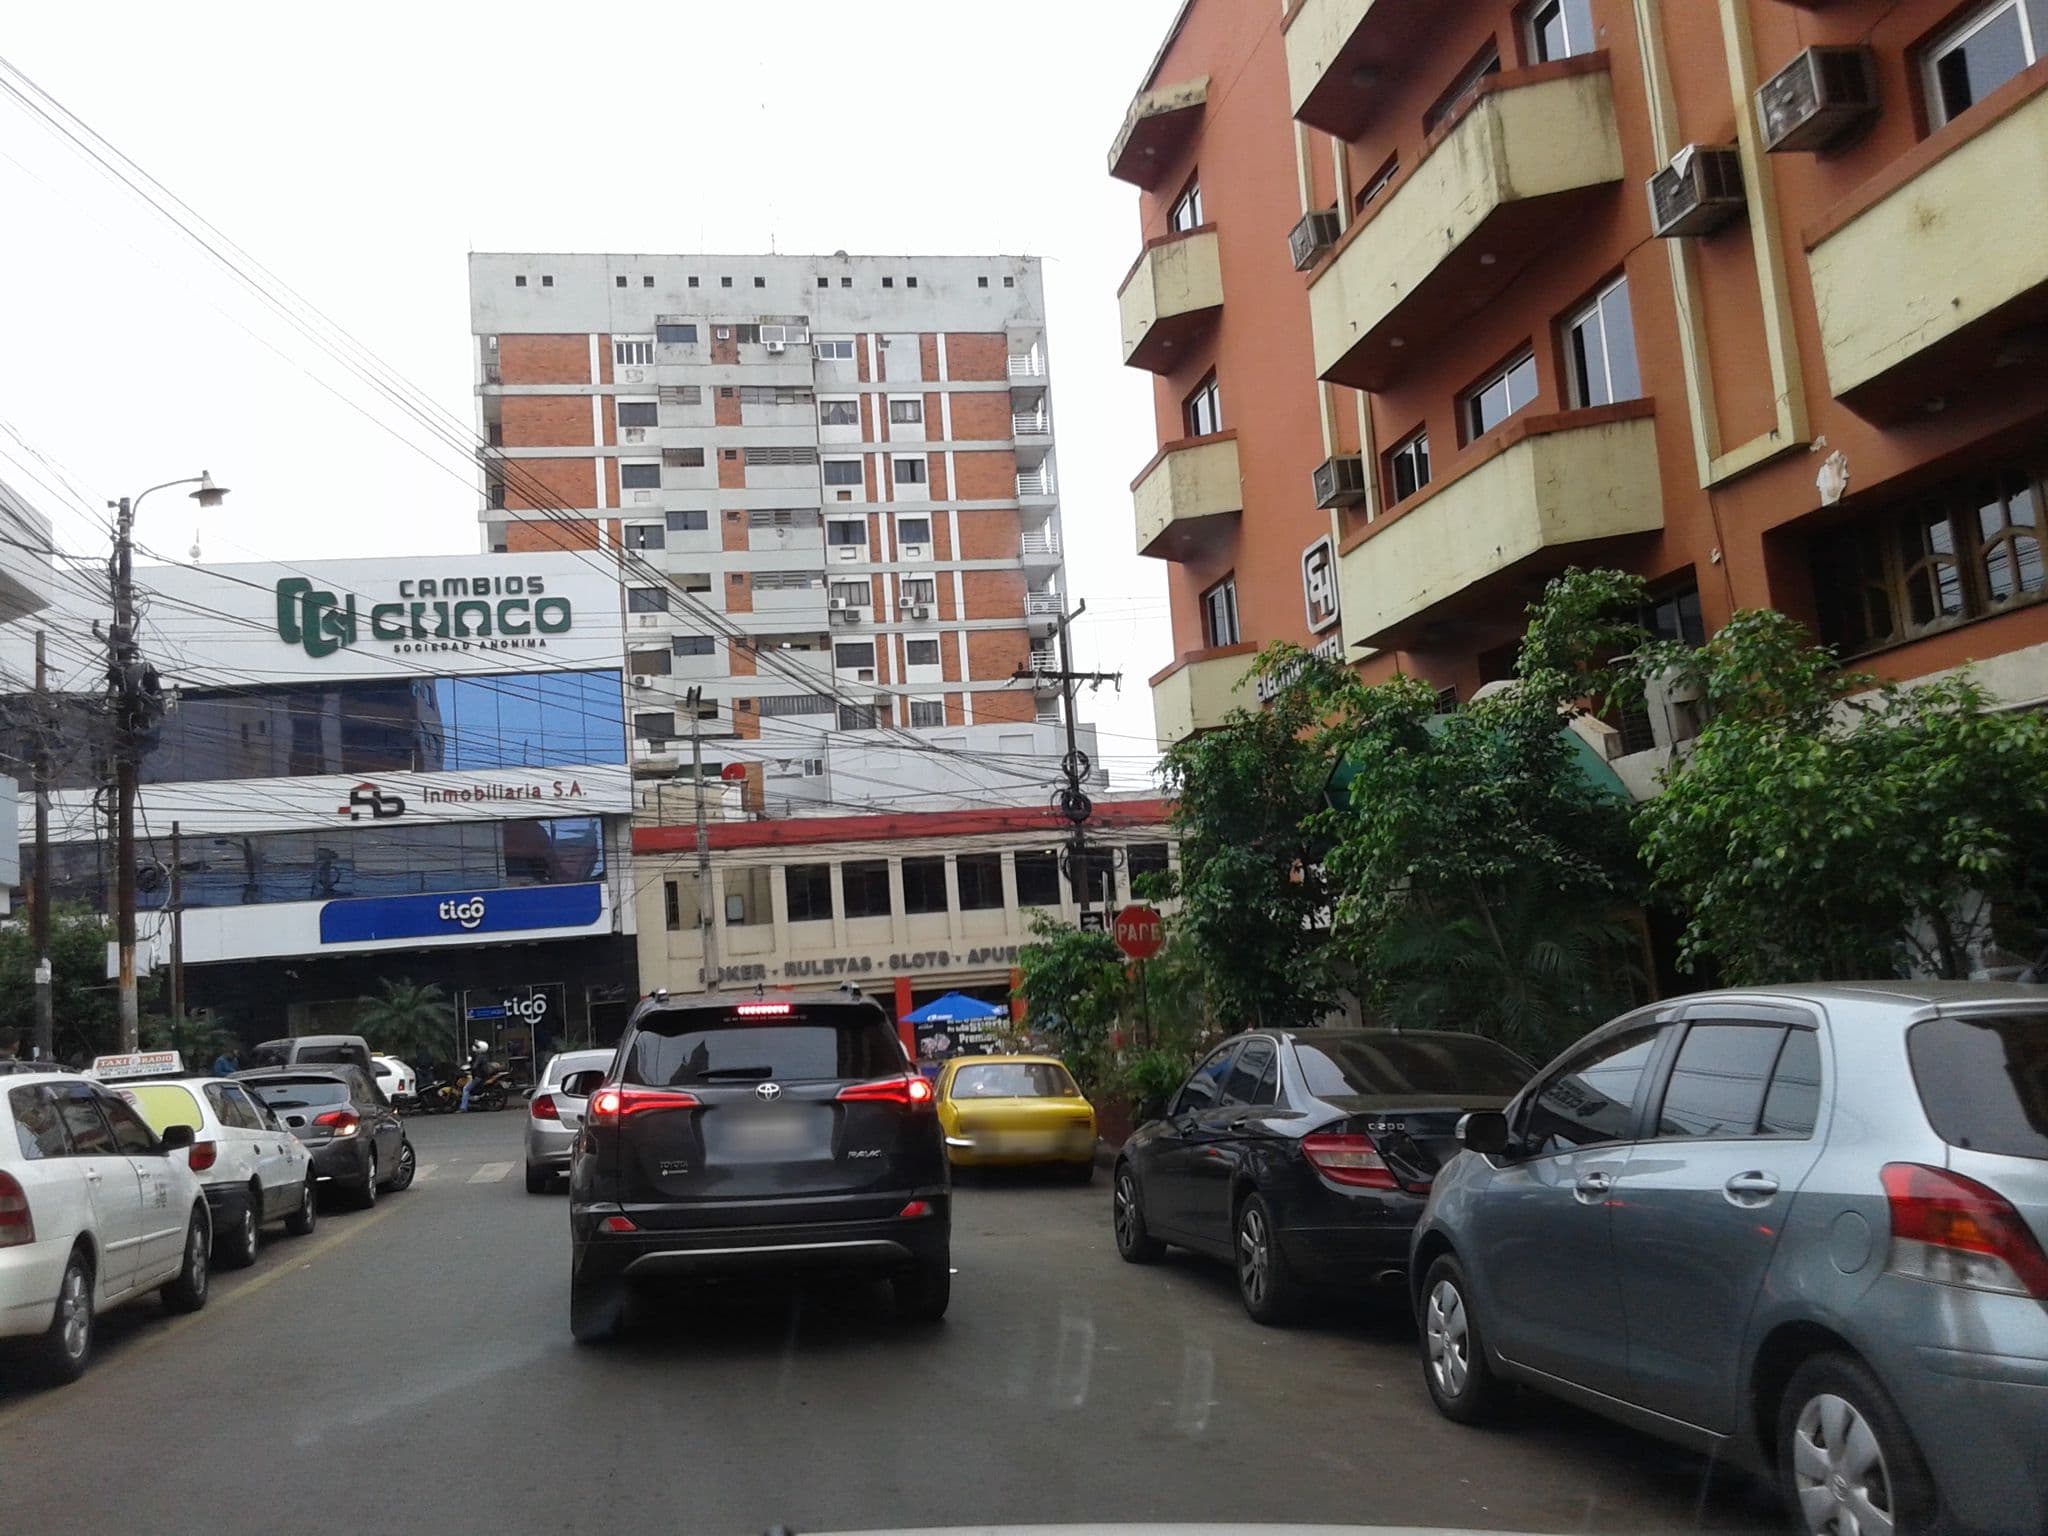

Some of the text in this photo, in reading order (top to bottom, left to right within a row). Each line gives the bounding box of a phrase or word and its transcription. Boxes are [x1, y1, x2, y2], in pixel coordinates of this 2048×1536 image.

[399, 575, 545, 598] CAMBIOS
[371, 597, 572, 641] CHACO
[393, 638, 547, 653] SOCIEDAD ANONIMA
[423, 783, 541, 804] Inmobiliaria
[553, 780, 587, 798] S.A.
[439, 896, 485, 928] tigo
[784, 956, 872, 978] RULETAS
[889, 951, 949, 970] SLOTS
[503, 994, 547, 1024] tigo
[100, 1055, 172, 1067] TAXI RADIO
